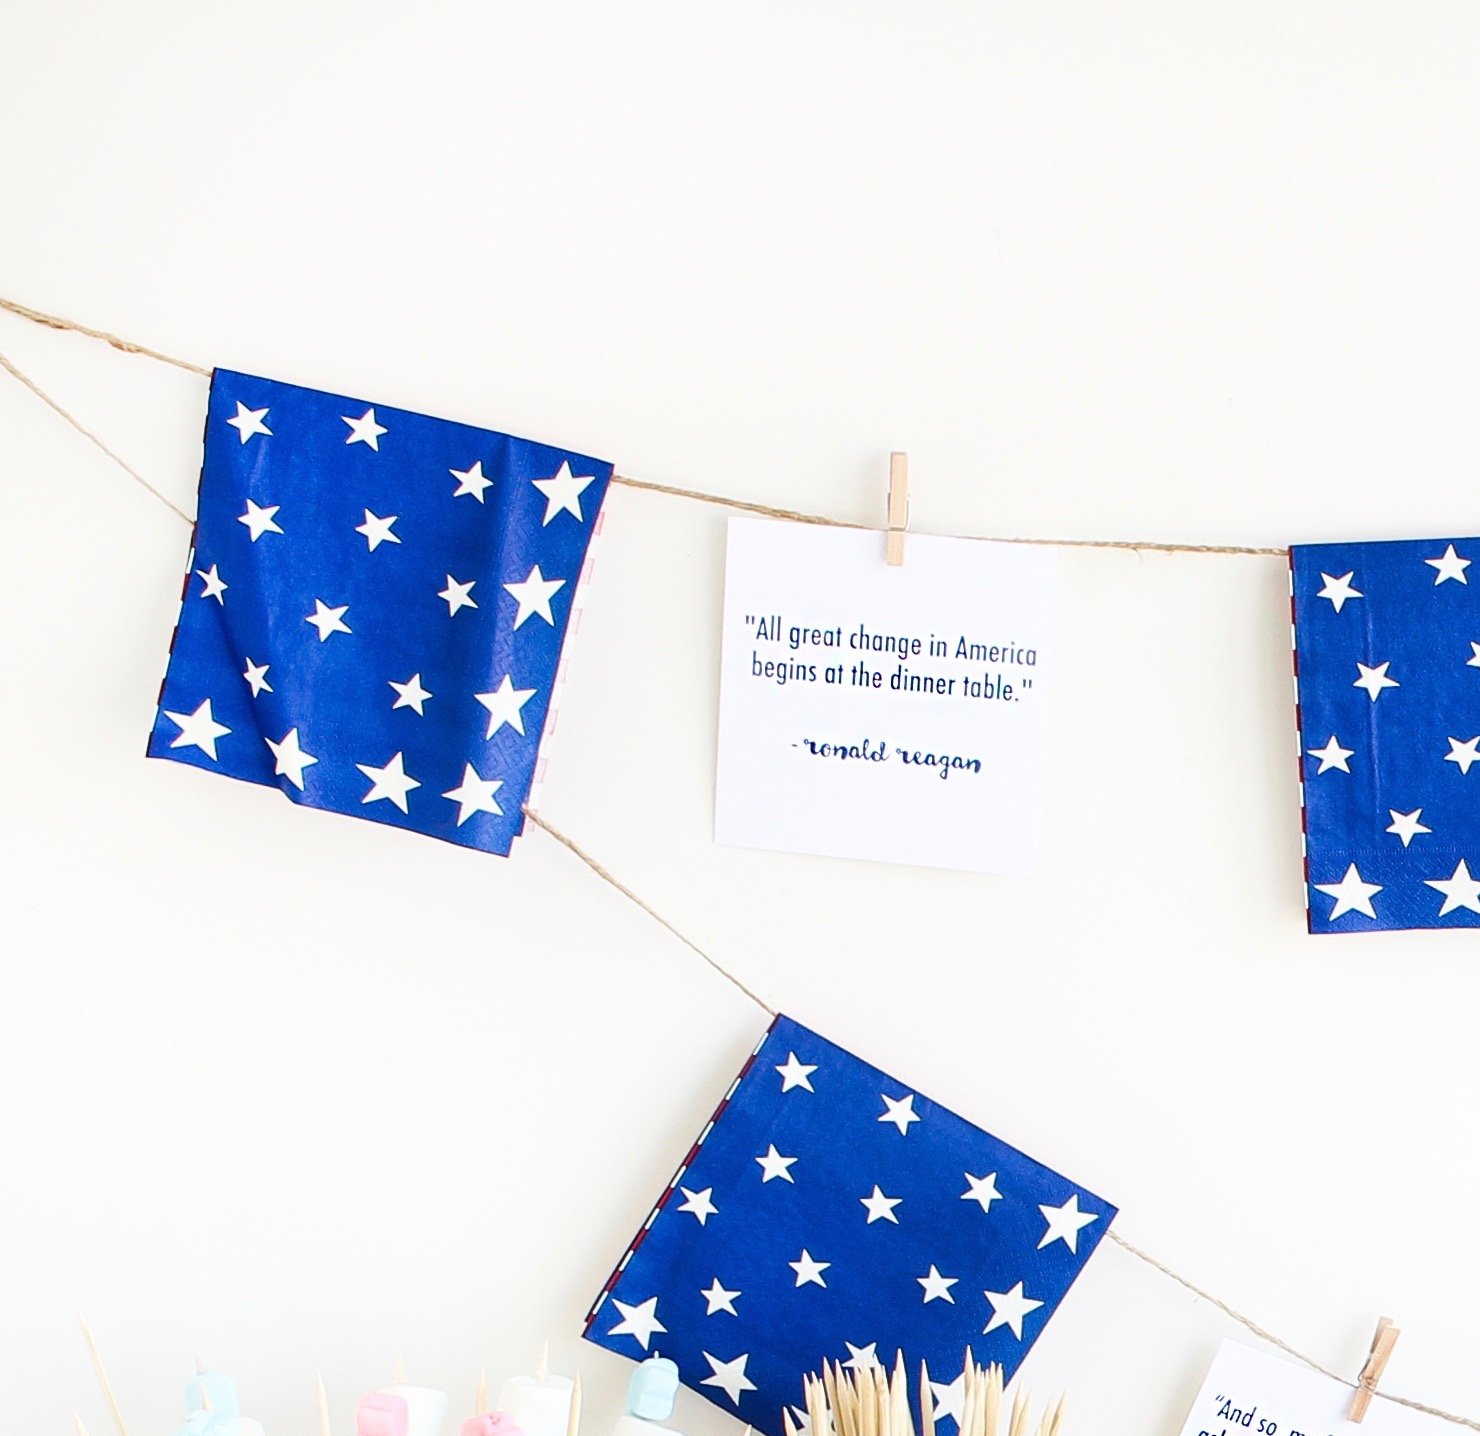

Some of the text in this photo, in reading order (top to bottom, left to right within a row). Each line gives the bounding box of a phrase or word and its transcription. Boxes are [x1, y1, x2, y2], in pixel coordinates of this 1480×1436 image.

[745, 615, 1037, 666] "All great change in America
[752, 650, 1033, 702] begins at the dinner table."
[895, 748, 982, 780] reagan
